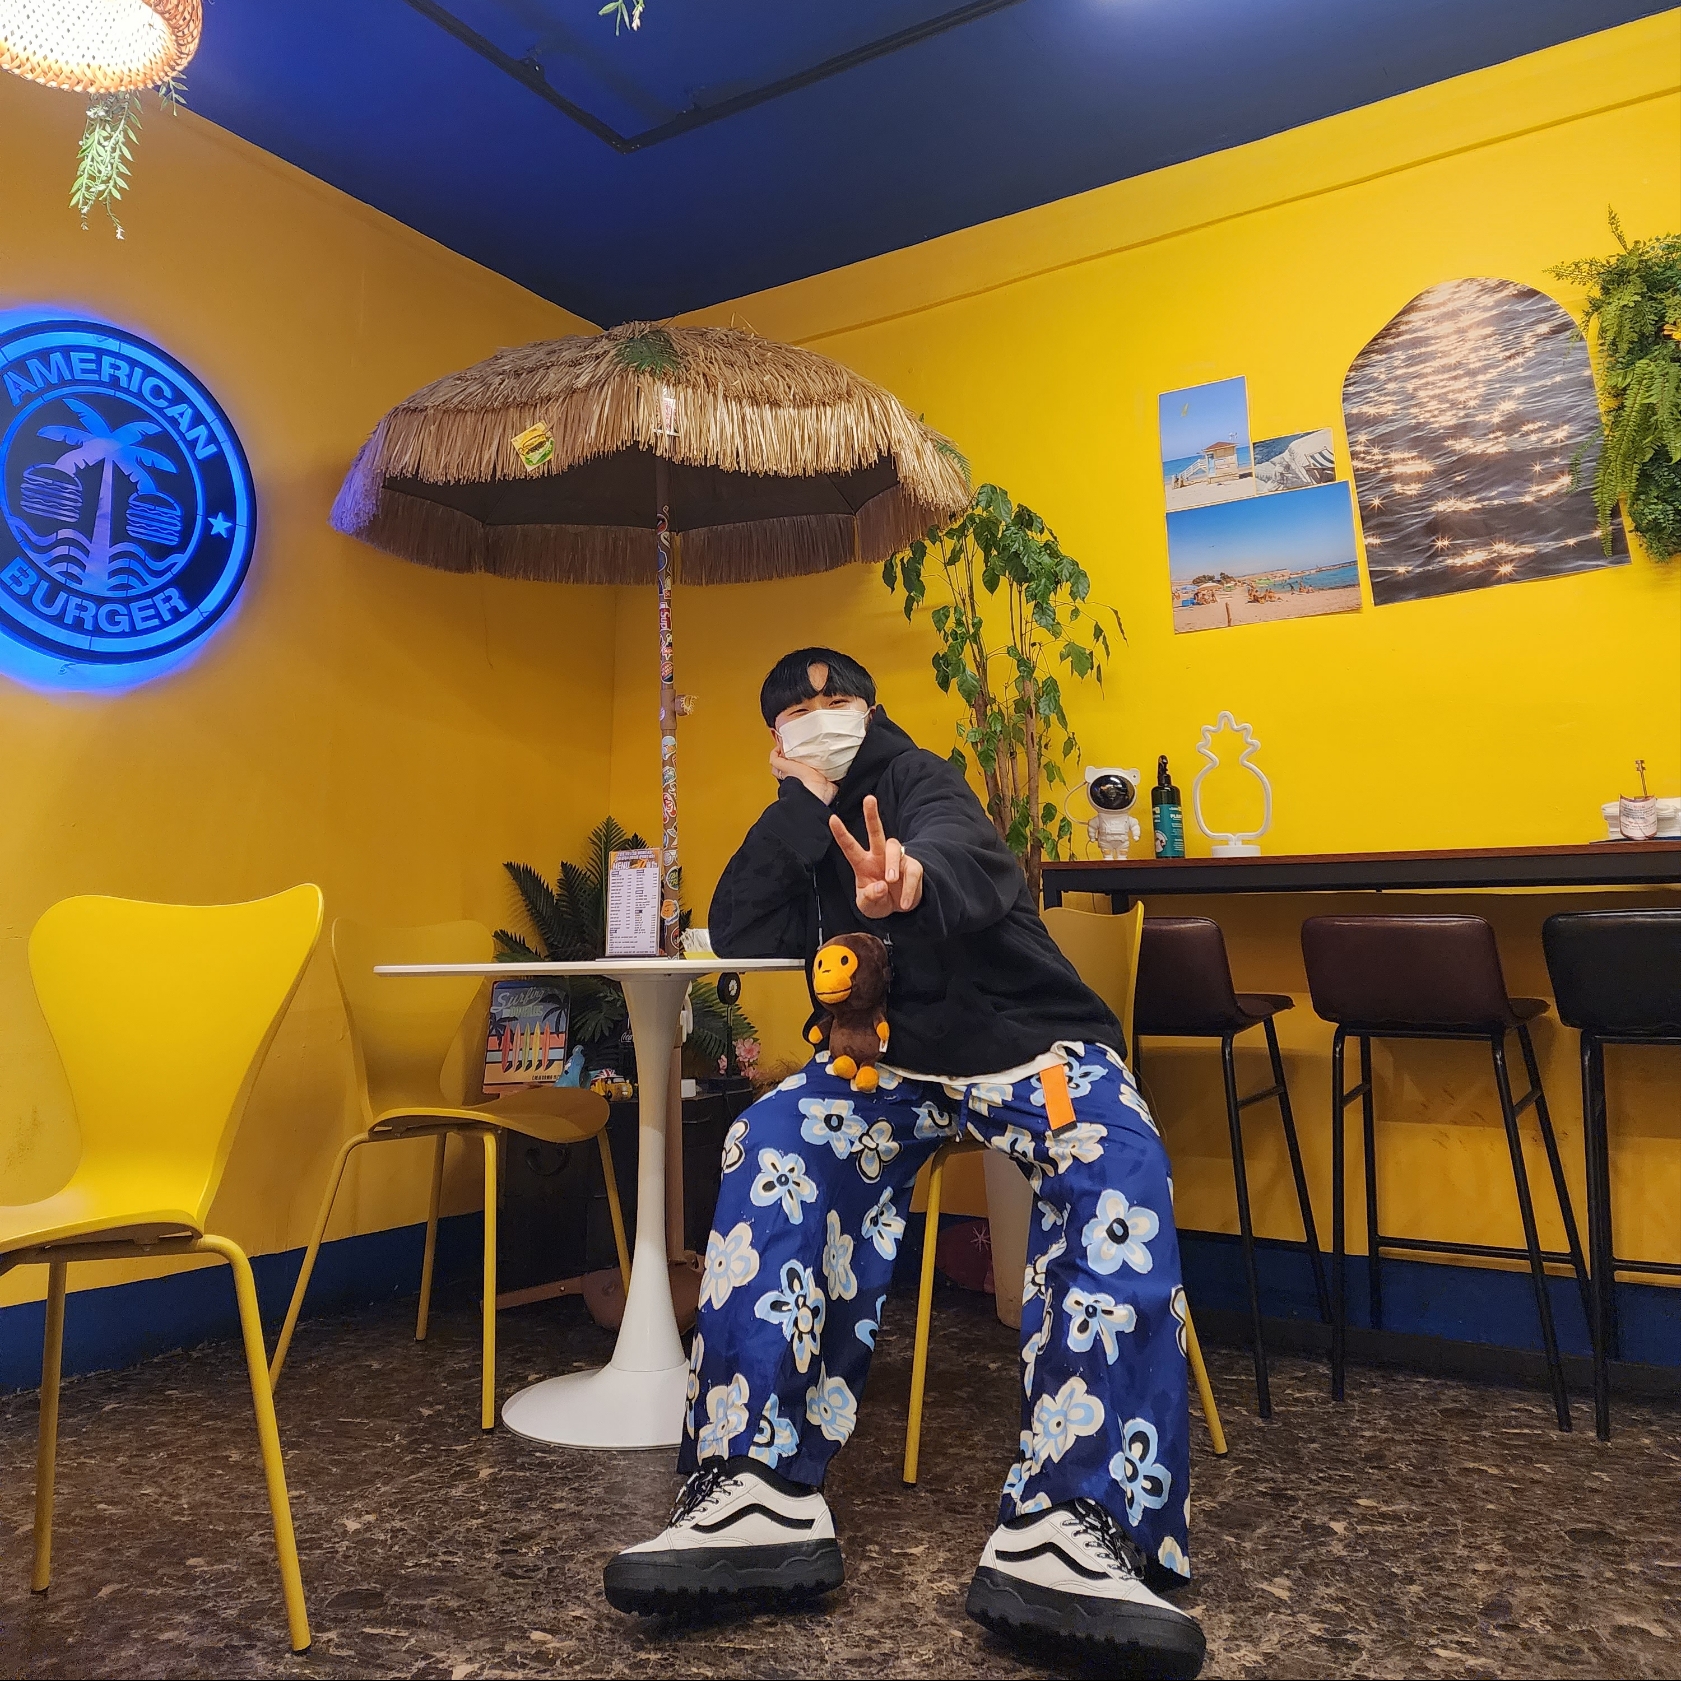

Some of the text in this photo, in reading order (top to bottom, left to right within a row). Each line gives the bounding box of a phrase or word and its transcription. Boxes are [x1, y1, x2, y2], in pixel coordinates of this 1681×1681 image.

[2, 352, 218, 462] AMERICAN
[0, 563, 188, 634] BURGER
[490, 986, 545, 1014] Surfing
